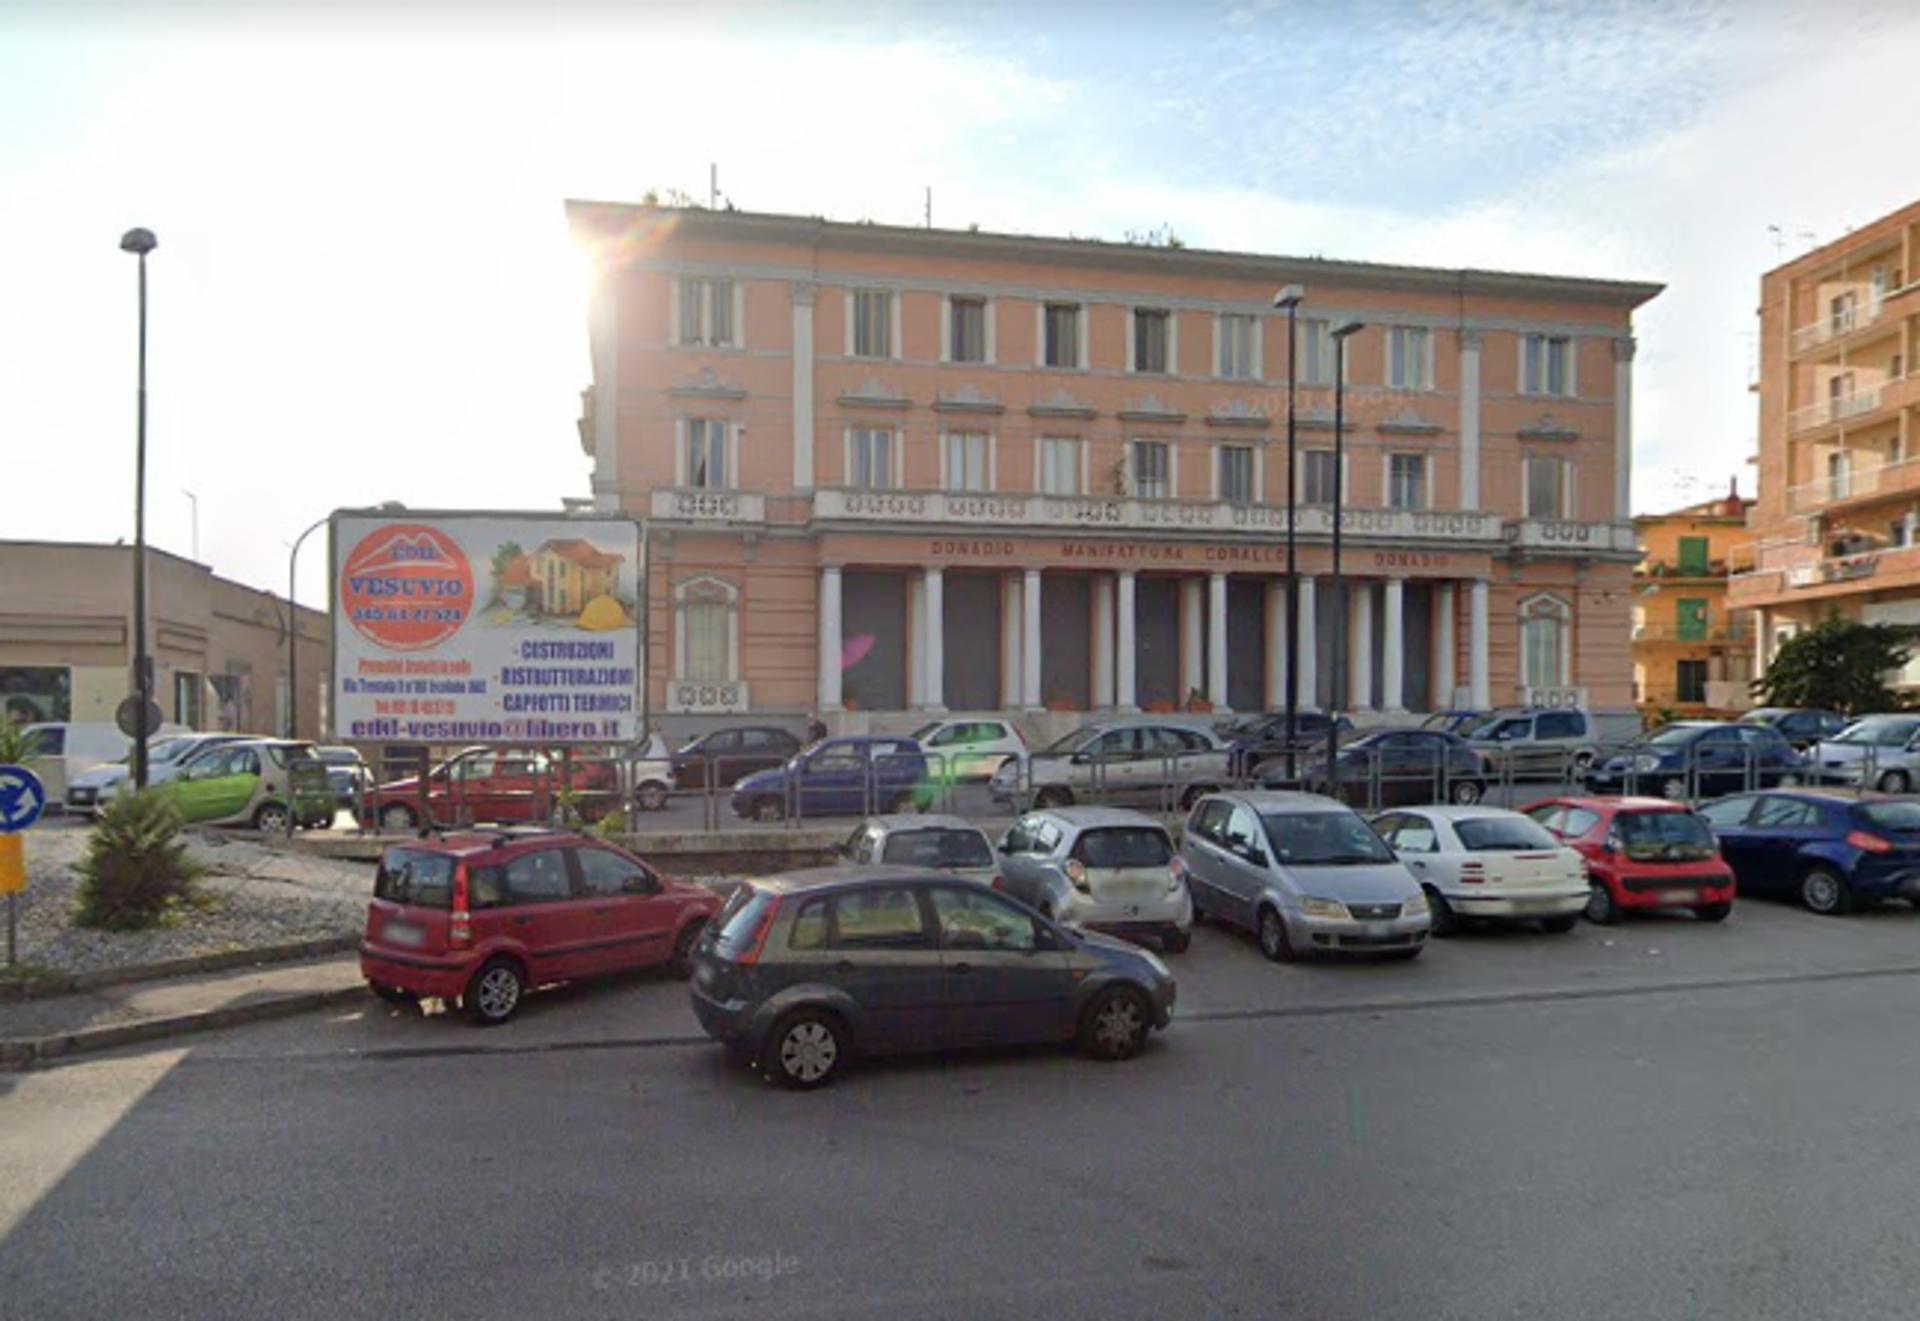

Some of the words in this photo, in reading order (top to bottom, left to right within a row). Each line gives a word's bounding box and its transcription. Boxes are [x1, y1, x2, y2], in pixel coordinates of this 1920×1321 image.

[931, 541, 1015, 556] DONADIO
[1061, 543, 1183, 560] MANIFATTURA
[1206, 547, 1285, 563] CORALLO
[1374, 553, 1450, 567] DONADIO
[349, 577, 463, 596] VESUVIO
[521, 640, 614, 660] COSTRUZIONI
[501, 667, 634, 687] RISTRUTTURAZIONI
[574, 693, 632, 714] TERMICI
[351, 718, 618, 738] edil-vesuvio@libero.it
